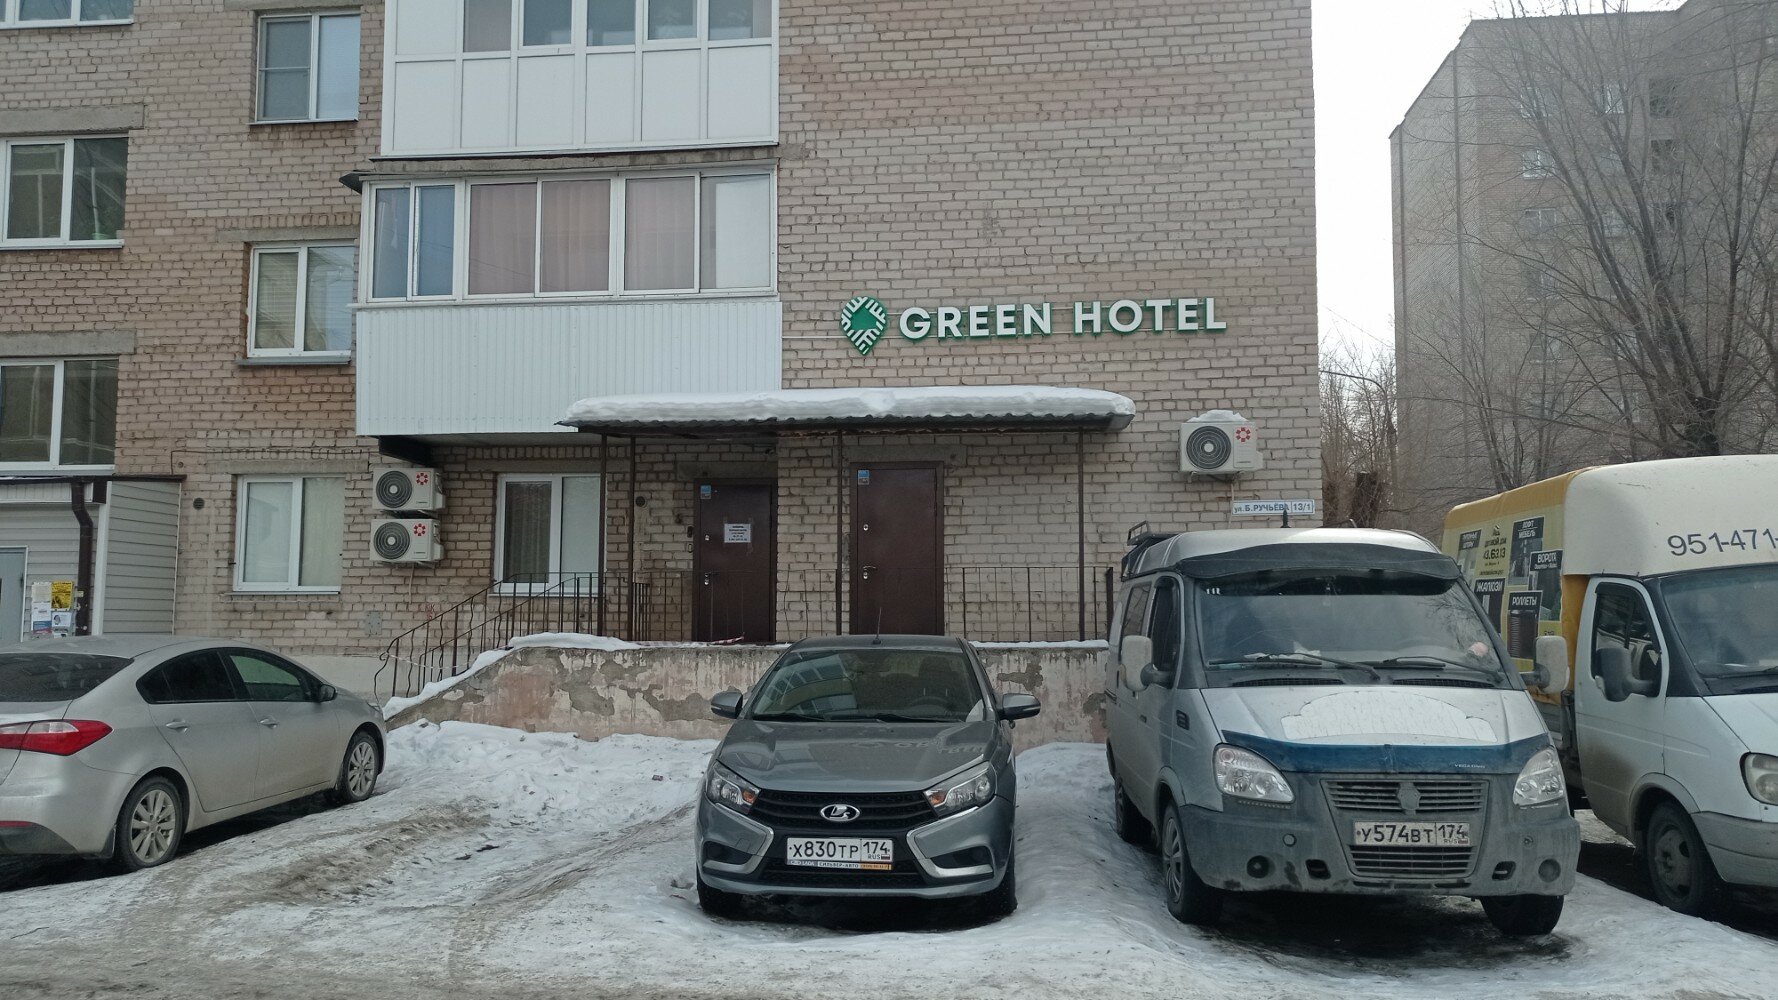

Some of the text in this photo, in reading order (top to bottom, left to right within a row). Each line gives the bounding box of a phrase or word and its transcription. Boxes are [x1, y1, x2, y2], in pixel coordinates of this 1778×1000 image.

[899, 297, 1227, 339] GREEN HOTEL
[1293, 502, 1311, 512] 13/1
[1512, 596, 1538, 606] РОЛЛЕТЫ
[1438, 824, 1466, 840] 174
[863, 841, 888, 854] 174
